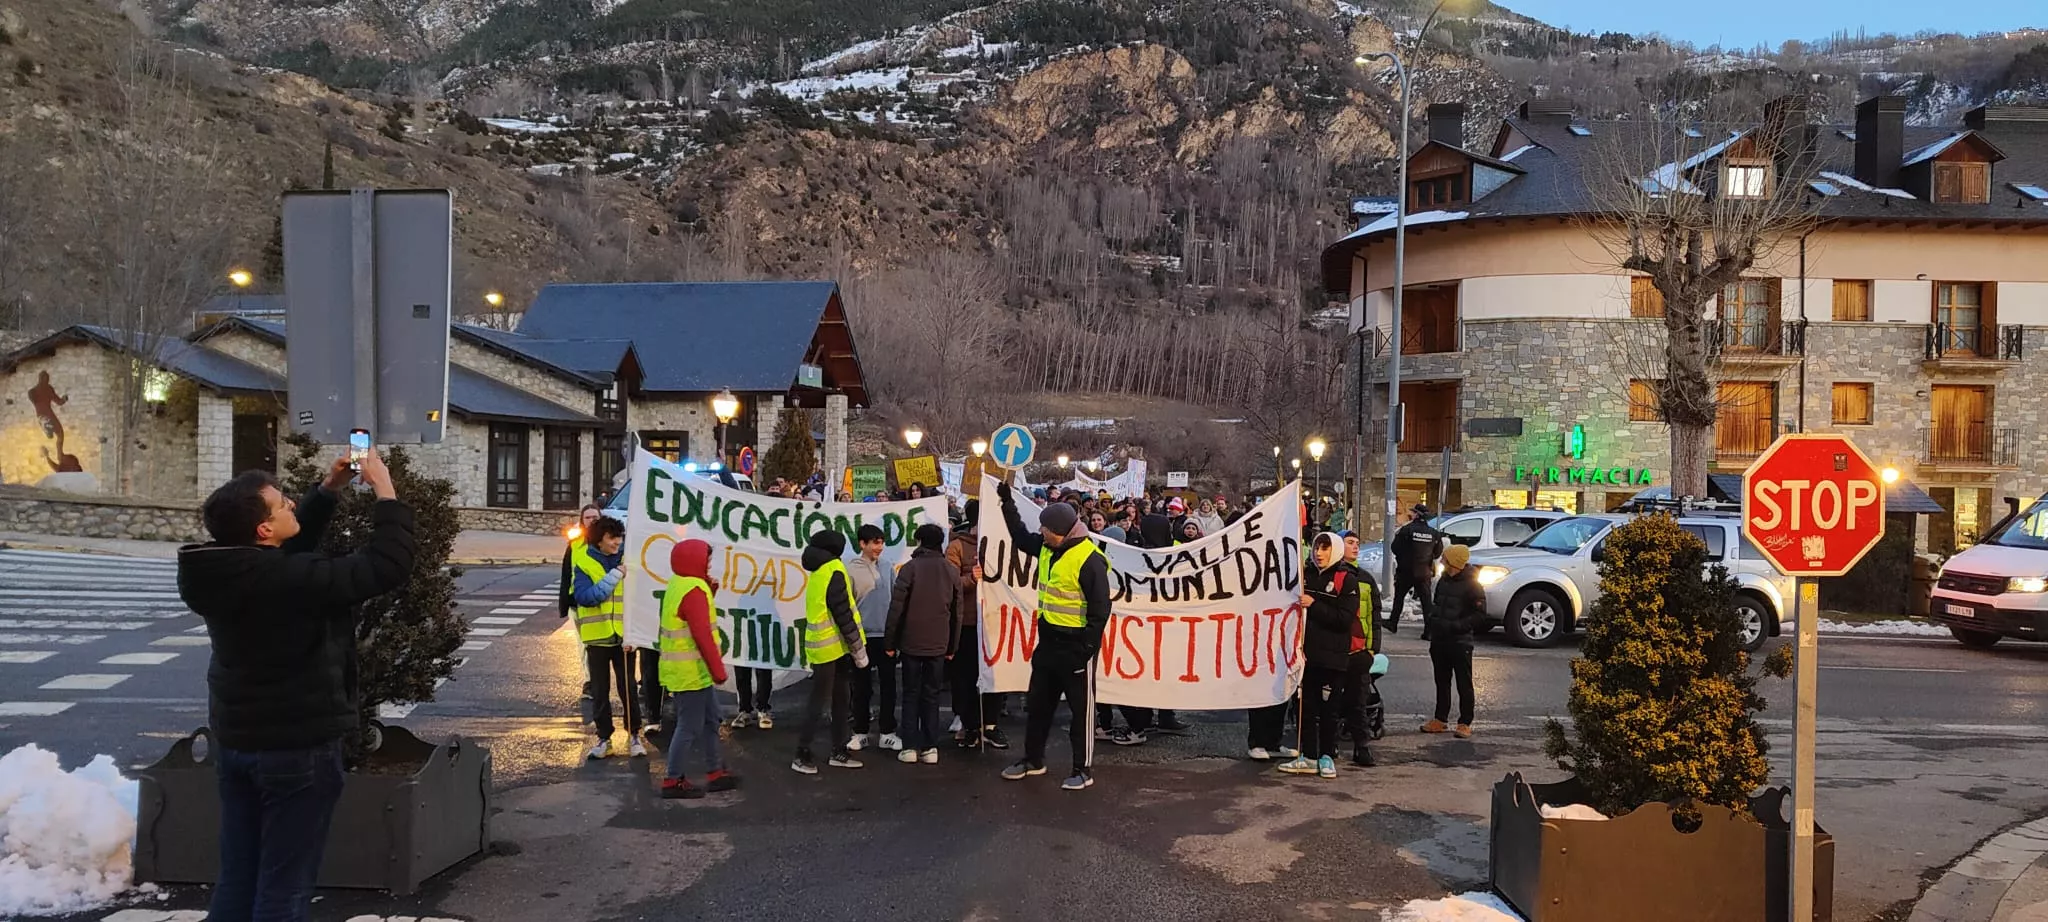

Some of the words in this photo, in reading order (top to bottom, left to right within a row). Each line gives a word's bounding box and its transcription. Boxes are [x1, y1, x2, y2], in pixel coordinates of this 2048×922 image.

[1514, 465, 1653, 486] FARMACIA
[1751, 479, 1877, 530] STOP
[882, 505, 925, 547] DE
[640, 533, 808, 602] CIDAD
[1111, 536, 1299, 603] OMUNIDAD
[980, 598, 1038, 668] UN
[1100, 602, 1301, 683] NSTITUTO
